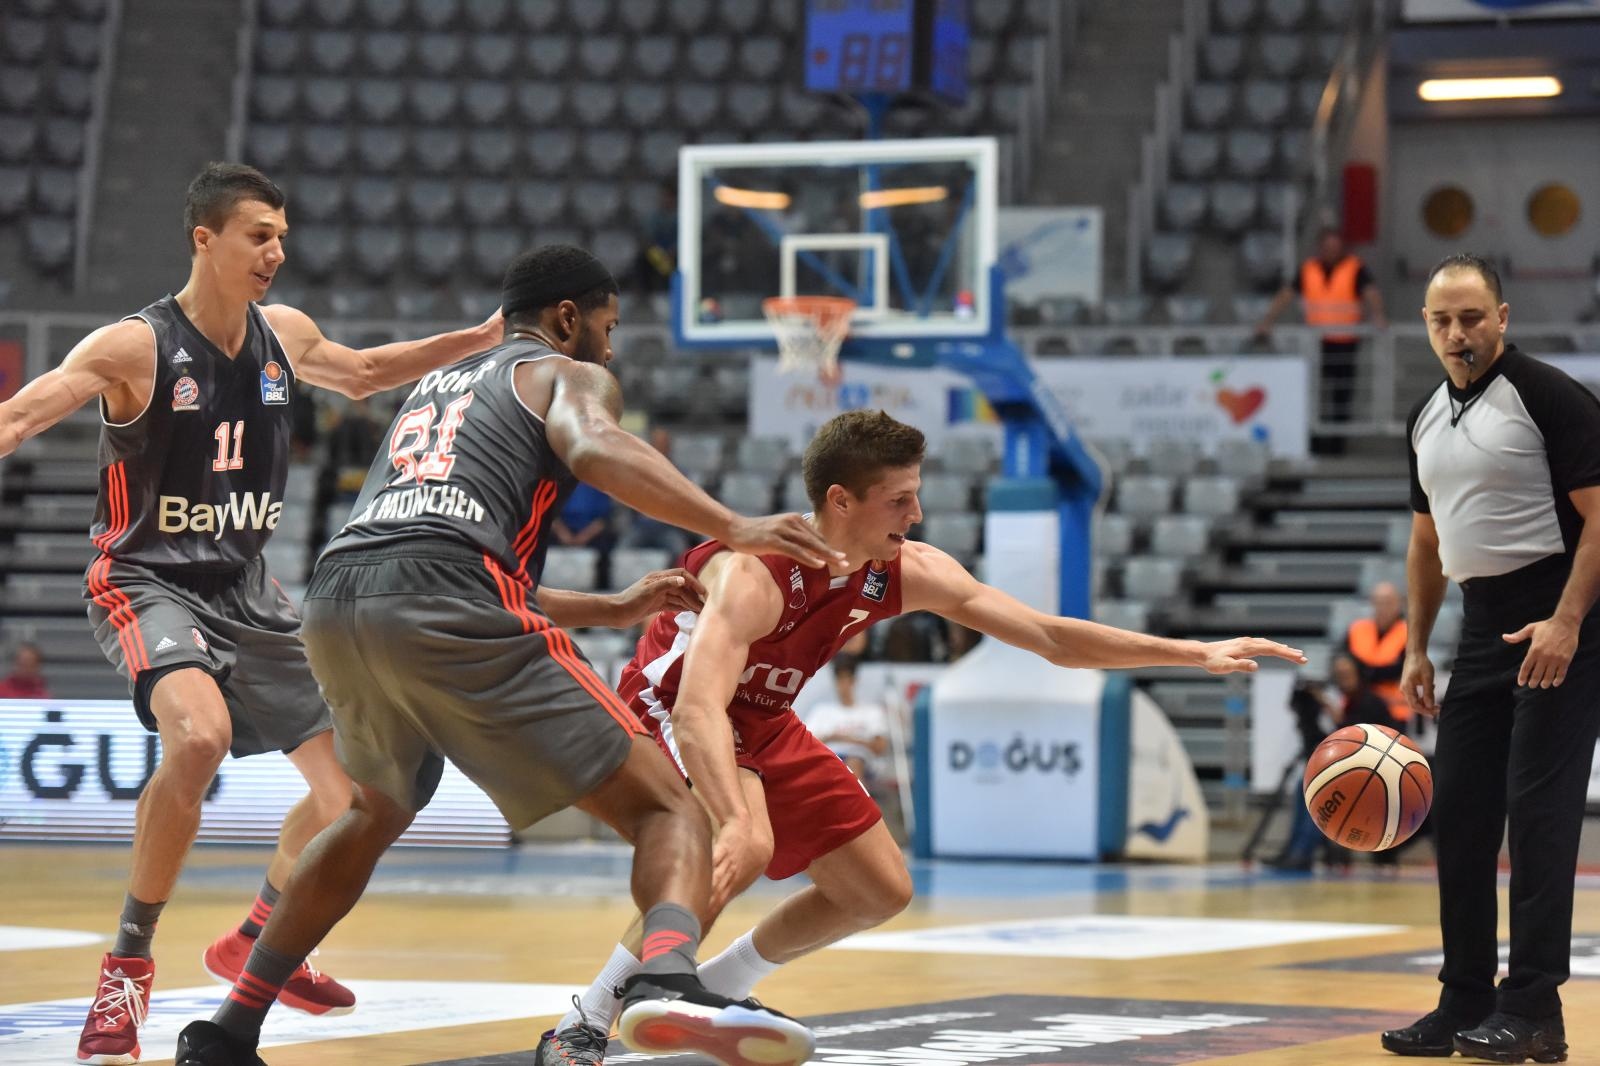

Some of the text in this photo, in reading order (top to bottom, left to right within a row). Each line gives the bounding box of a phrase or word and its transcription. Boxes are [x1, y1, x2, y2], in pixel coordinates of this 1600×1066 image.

[172, 356, 193, 364] adidas
[265, 391, 286, 401] BBL
[212, 420, 245, 472] 11
[862, 582, 880, 598] BBL
[839, 608, 871, 636] 7
[755, 693, 776, 707] für
[780, 700, 790, 711] A
